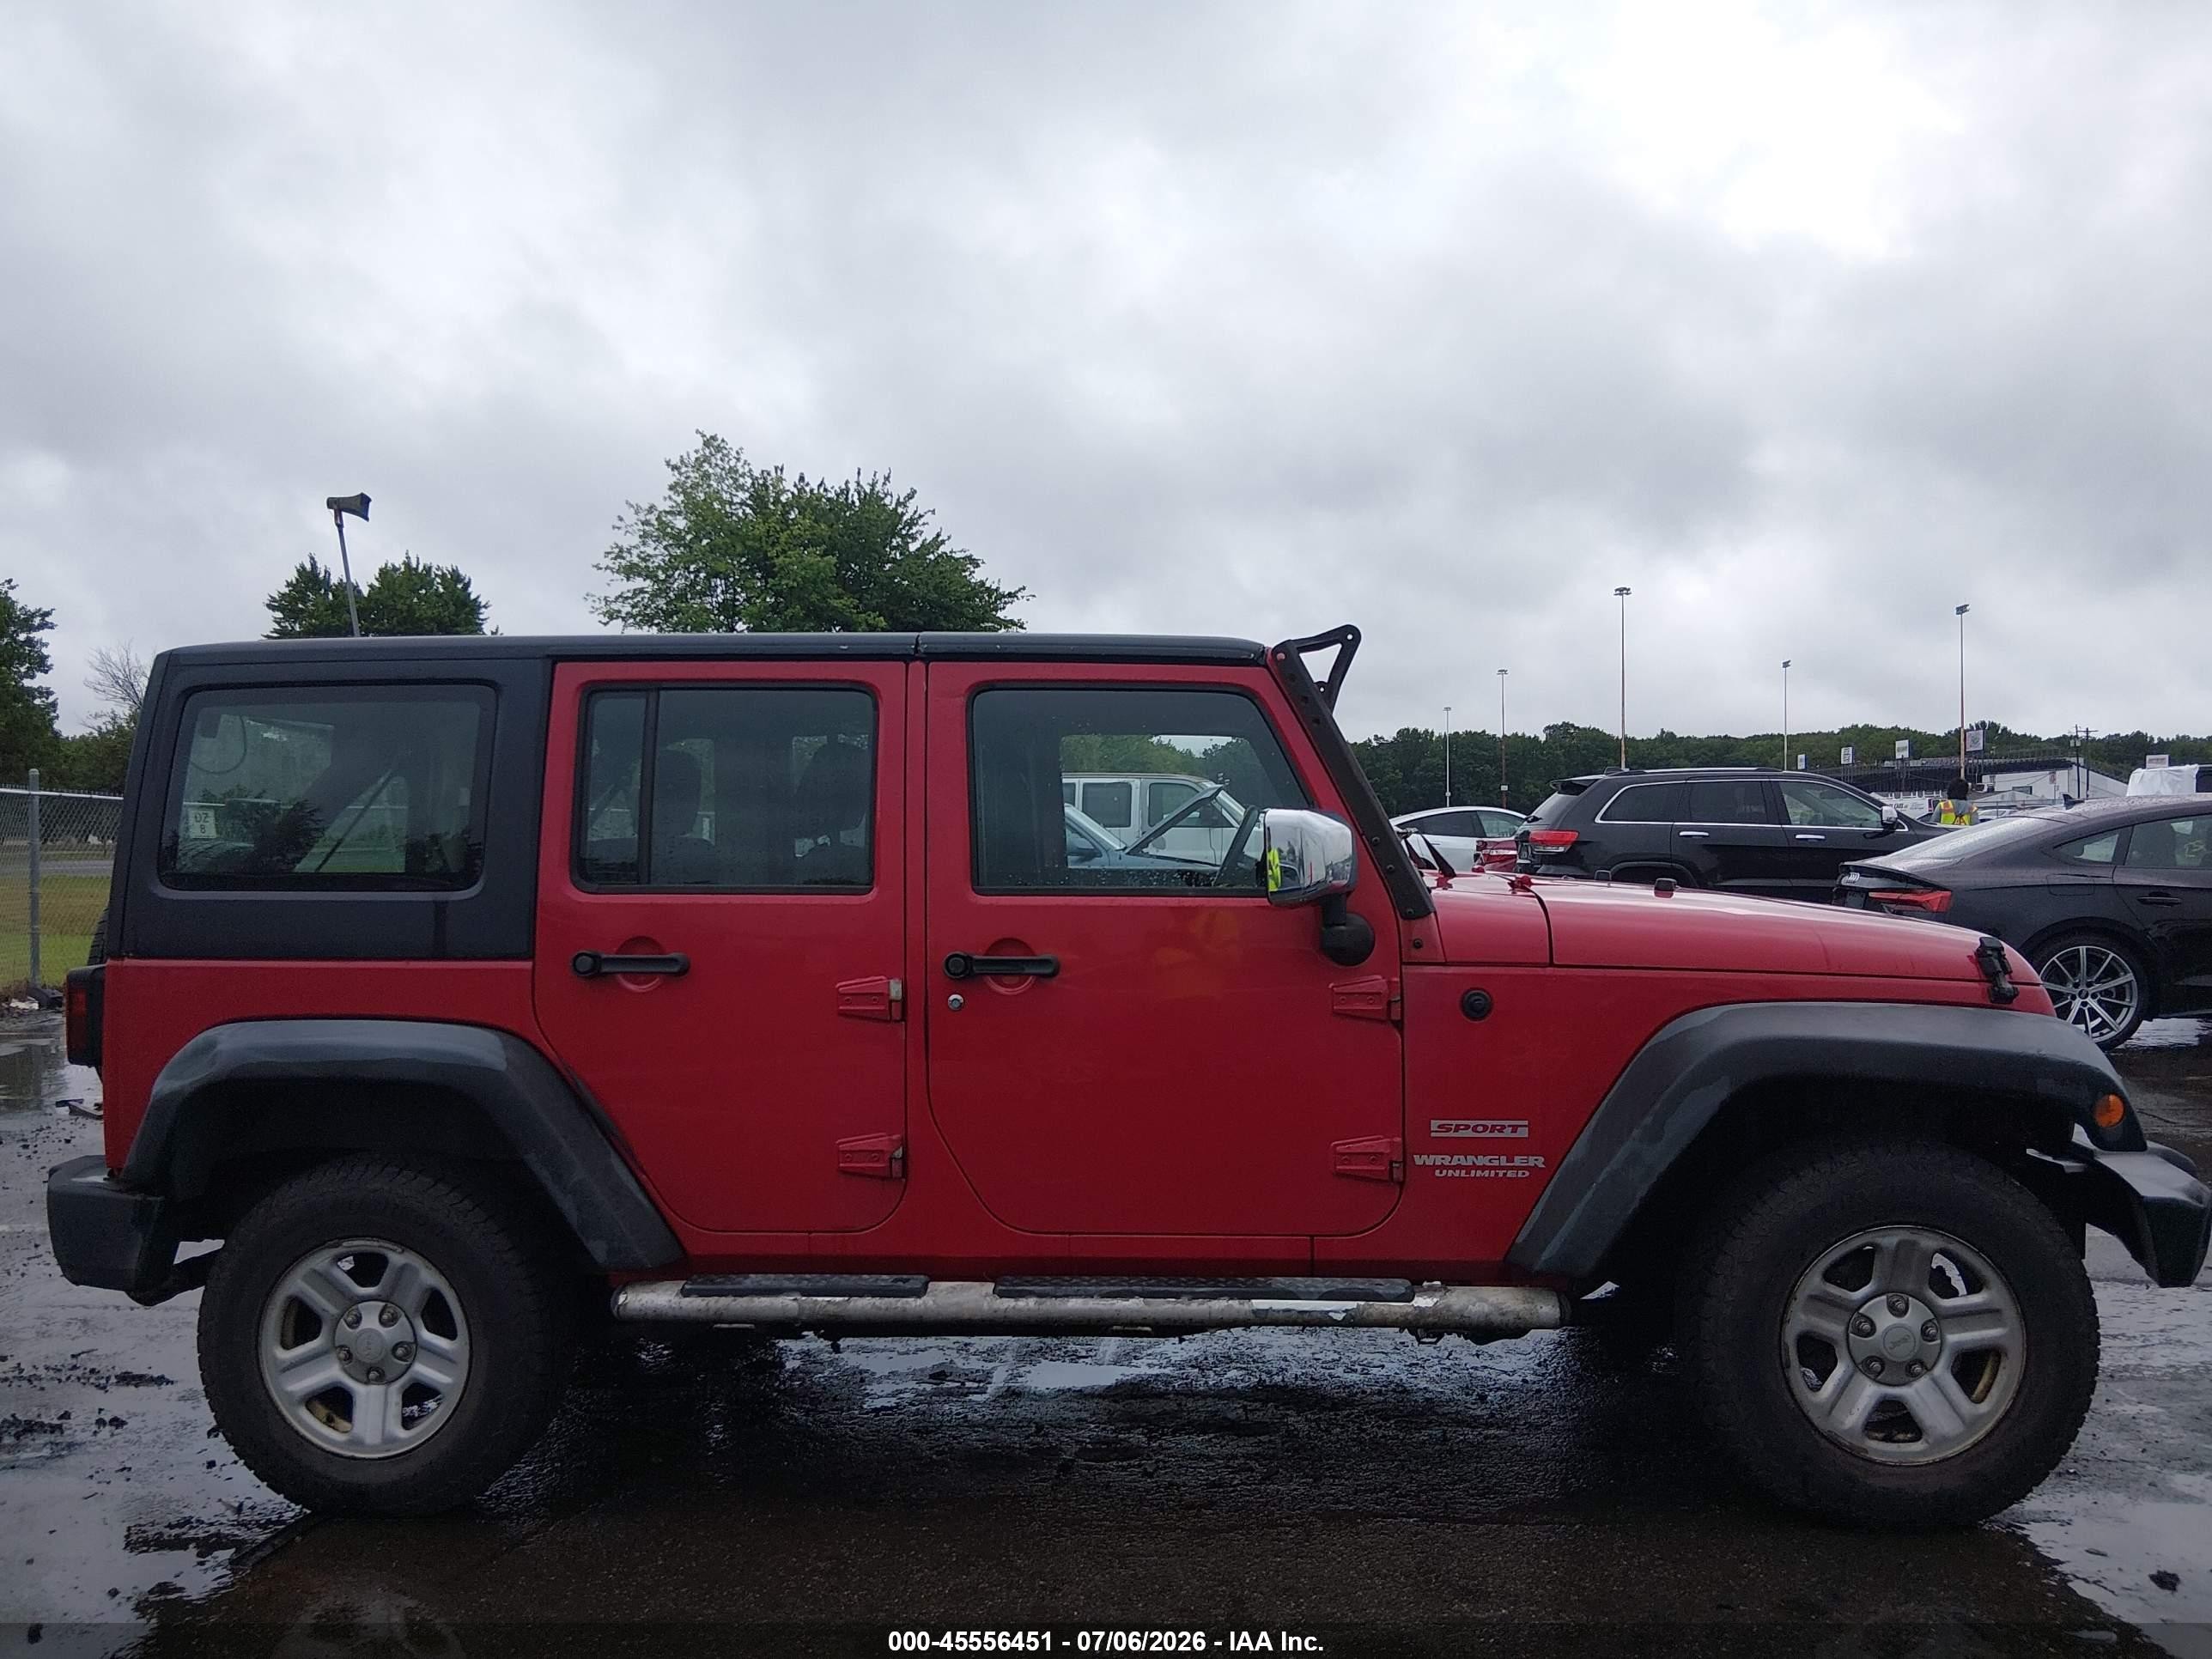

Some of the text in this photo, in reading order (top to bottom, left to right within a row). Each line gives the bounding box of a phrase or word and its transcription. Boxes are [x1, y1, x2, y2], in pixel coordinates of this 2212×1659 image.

[199, 824, 206, 834] 8
[1433, 1122, 1526, 1134] SPORT
[1413, 1155, 1546, 1167] WRANGLER
